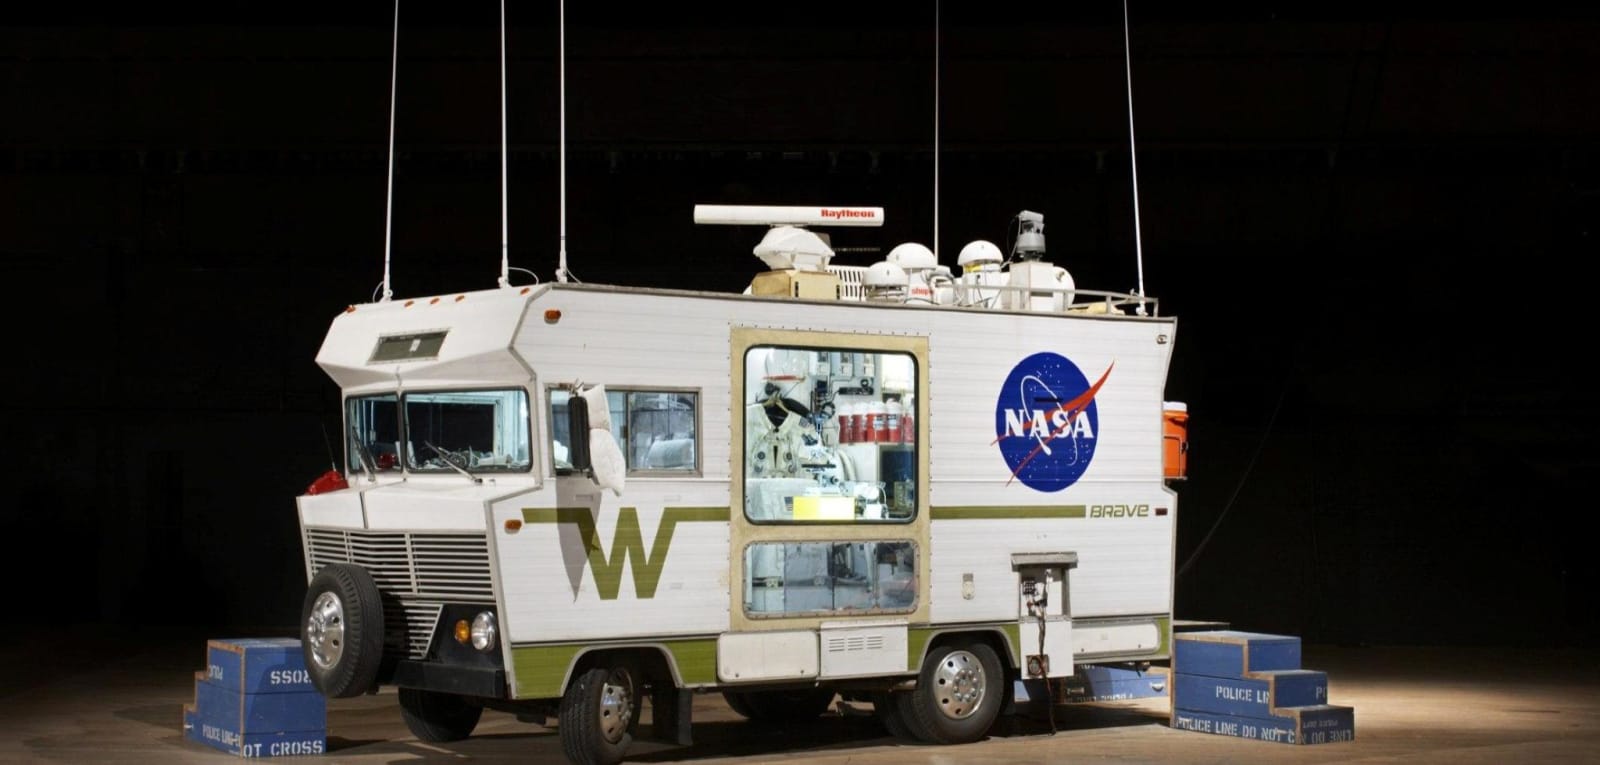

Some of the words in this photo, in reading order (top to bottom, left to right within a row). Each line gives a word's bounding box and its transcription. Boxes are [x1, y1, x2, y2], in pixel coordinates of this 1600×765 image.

[821, 209, 875, 219] Raytheon
[1004, 408, 1095, 439] NASA
[1215, 685, 1253, 702] POLICE
[202, 723, 221, 742] POLICE
[1215, 720, 1238, 737] LINE
[1242, 725, 1257, 738] DO
[1260, 727, 1282, 742] NOT
[1311, 731, 1325, 744] DO
[1329, 729, 1352, 743] LINE
[243, 743, 263, 758] OT
[270, 740, 323, 756] CROSS
